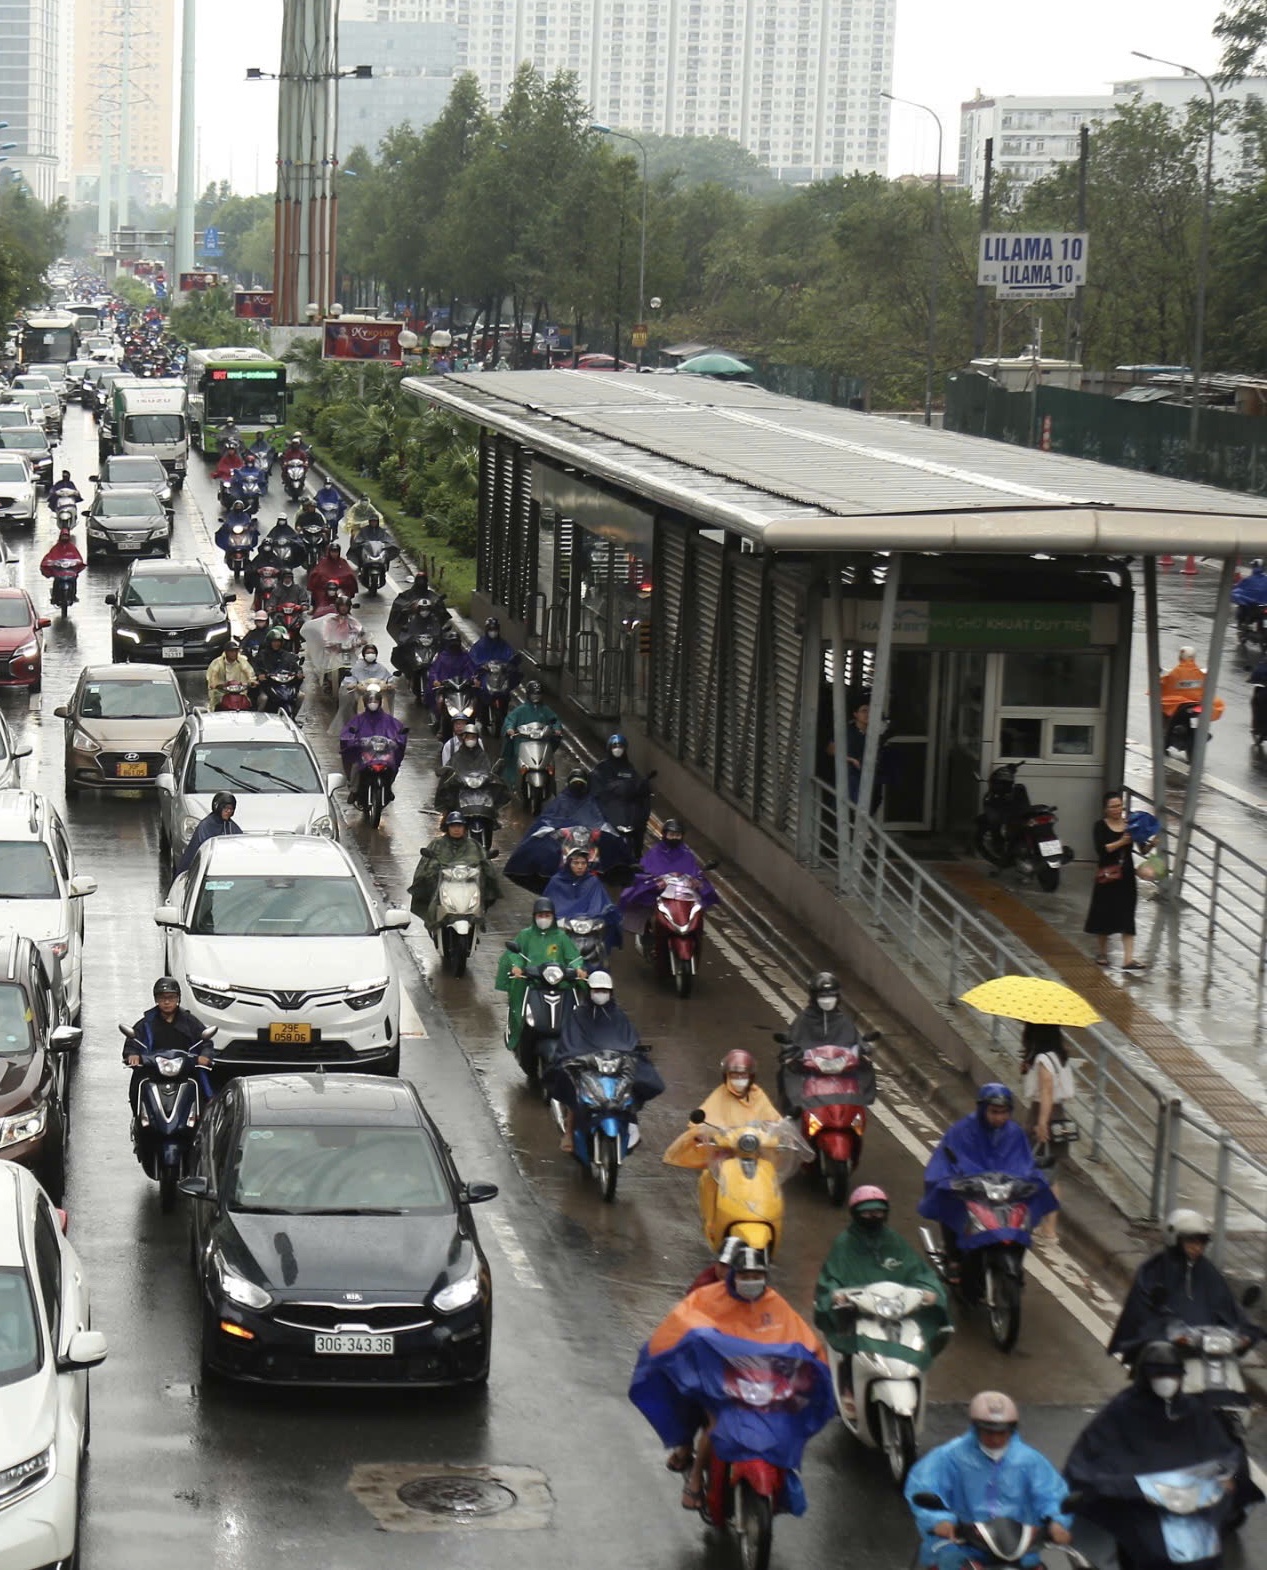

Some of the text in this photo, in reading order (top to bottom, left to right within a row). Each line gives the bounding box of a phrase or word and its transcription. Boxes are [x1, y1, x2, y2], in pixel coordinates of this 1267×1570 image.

[984, 238, 1083, 261] LILAMA 10
[1002, 265, 1052, 284] LILAMA
[1057, 265, 1073, 283] 10
[282, 1024, 299, 1033] 29E
[316, 1337, 392, 1352] 30G-343.36
